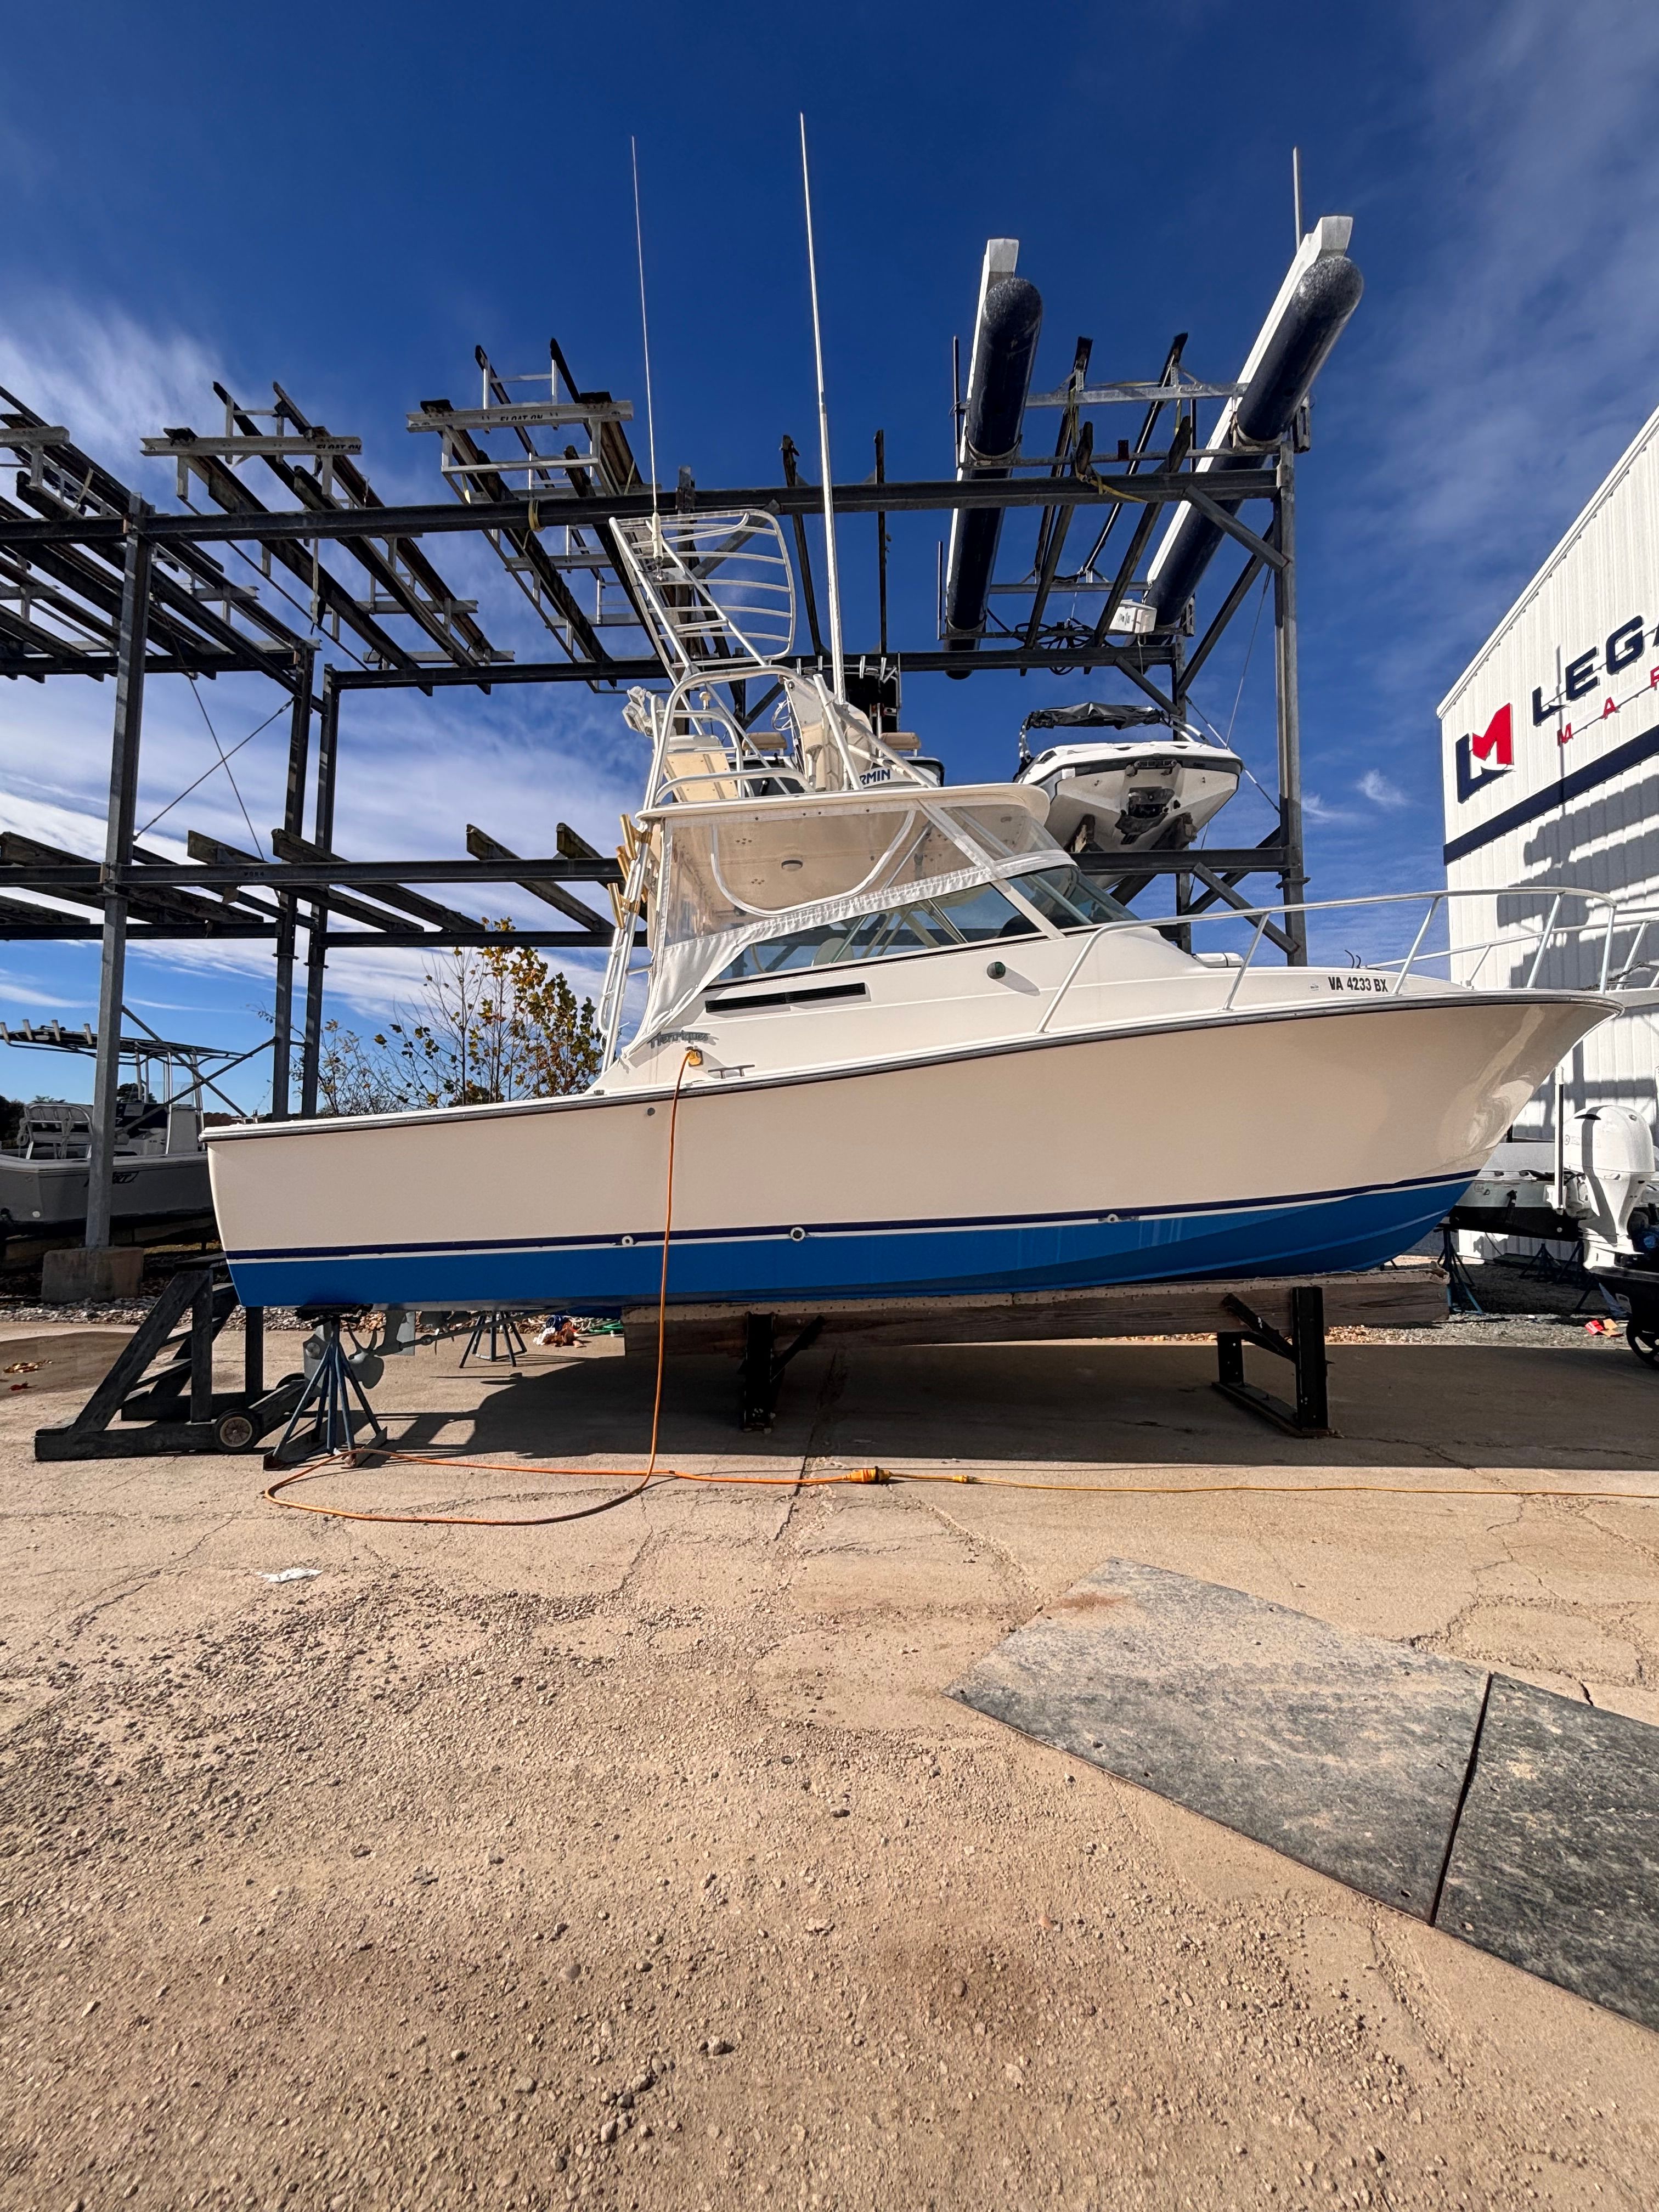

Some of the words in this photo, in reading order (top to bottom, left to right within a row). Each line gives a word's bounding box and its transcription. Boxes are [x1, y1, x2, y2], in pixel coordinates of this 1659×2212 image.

[1532, 615, 1659, 726] LEG
[859, 769, 891, 786] RMIN
[1328, 977, 1344, 991] VA
[1347, 977, 1372, 991] 4233
[1373, 978, 1389, 992] BX
